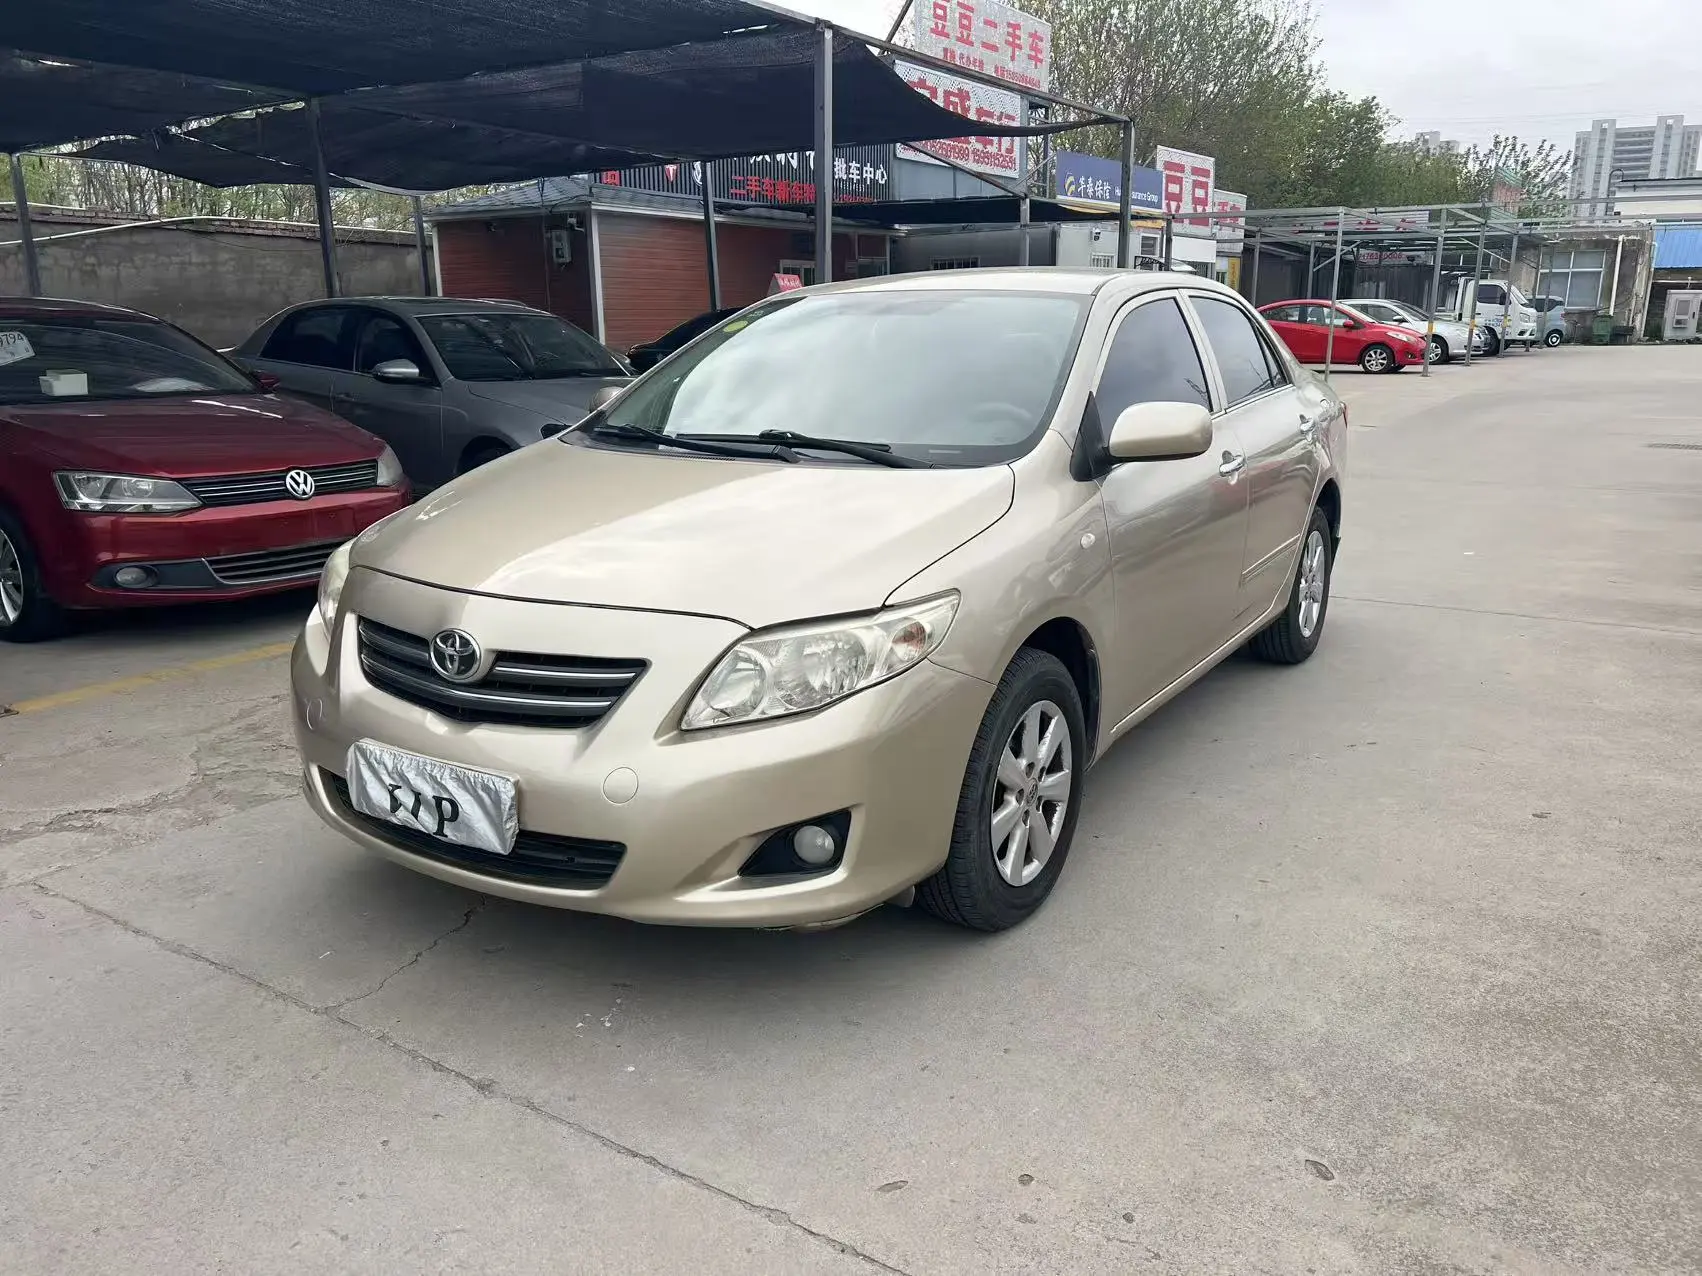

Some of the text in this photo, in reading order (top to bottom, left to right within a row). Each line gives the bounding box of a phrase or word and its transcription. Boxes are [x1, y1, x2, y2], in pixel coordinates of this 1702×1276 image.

[930, 0, 1046, 69] 豆豆二手车
[1078, 175, 1111, 200] 华泰保险
[1147, 191, 1159, 204] Group
[1163, 160, 1211, 226] 豆豆
